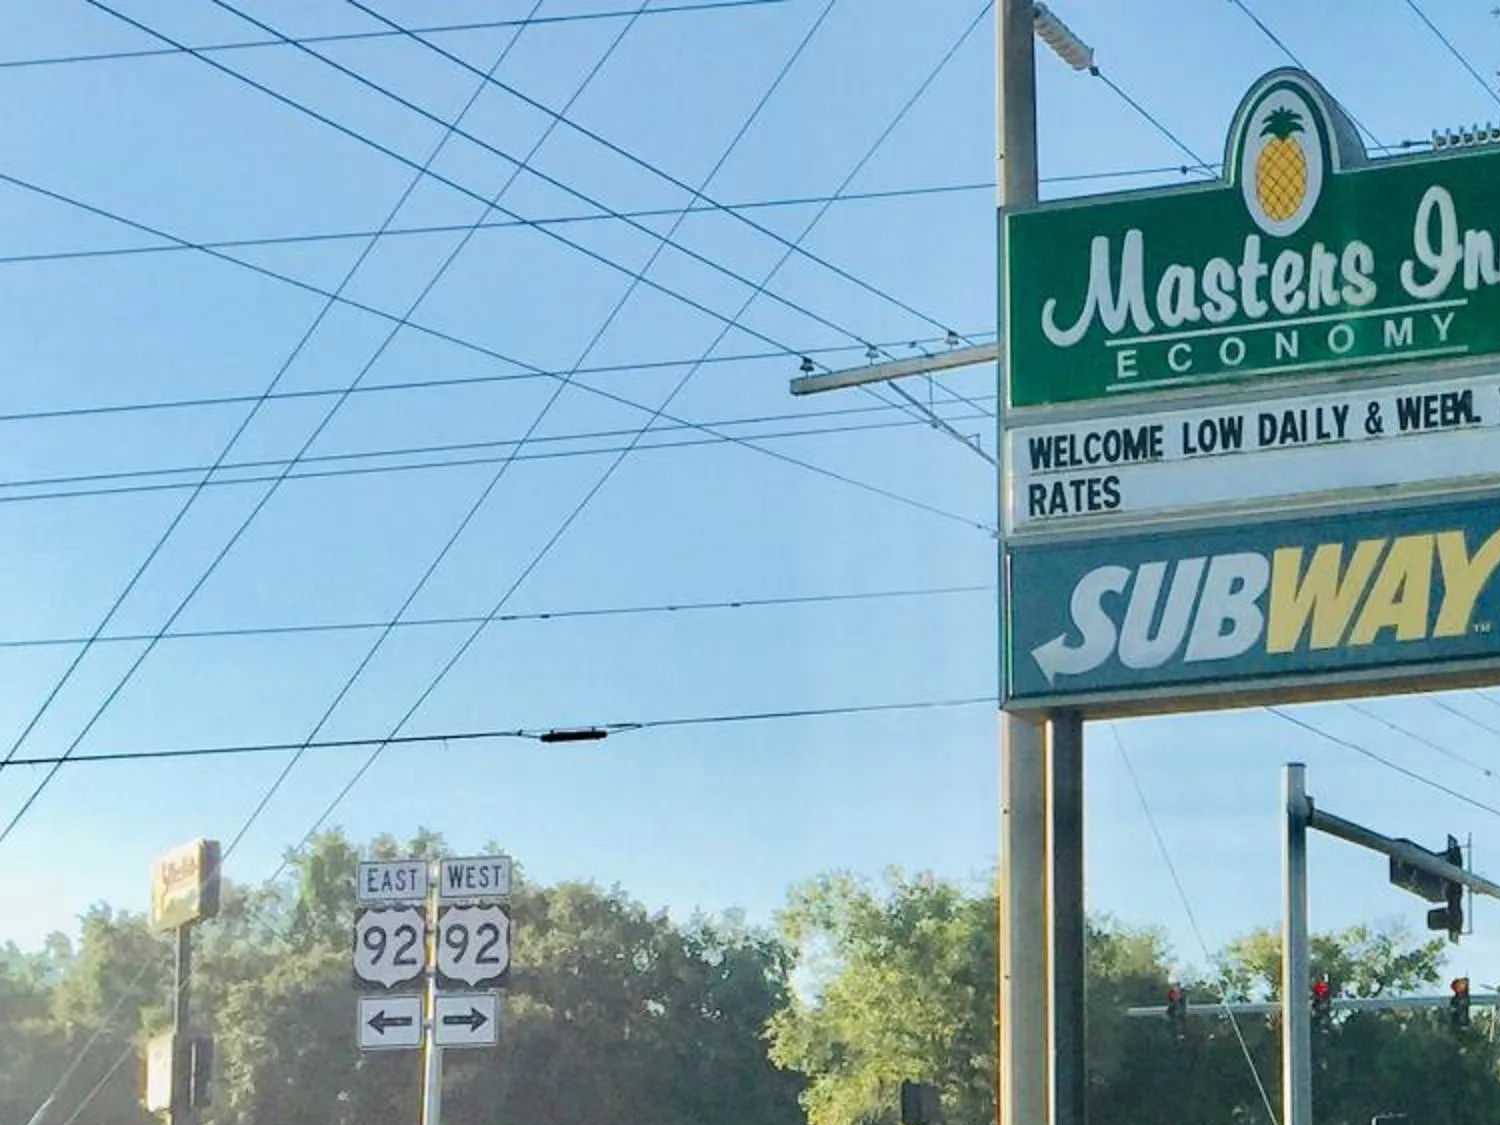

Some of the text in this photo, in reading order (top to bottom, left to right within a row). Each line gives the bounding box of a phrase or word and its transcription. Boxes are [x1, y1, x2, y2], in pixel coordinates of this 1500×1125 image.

[1042, 228, 1377, 347] Masters
[1117, 311, 1455, 379] ECONOMY
[1028, 424, 1164, 470] WELCOME
[1182, 415, 1244, 455] LOW
[1258, 404, 1350, 446] DAILY
[1364, 401, 1384, 435] &
[1028, 475, 1121, 517] RATES
[367, 868, 417, 892] EAST
[447, 864, 502, 889] WEST
[363, 924, 417, 966] 92
[445, 922, 500, 965] 92
